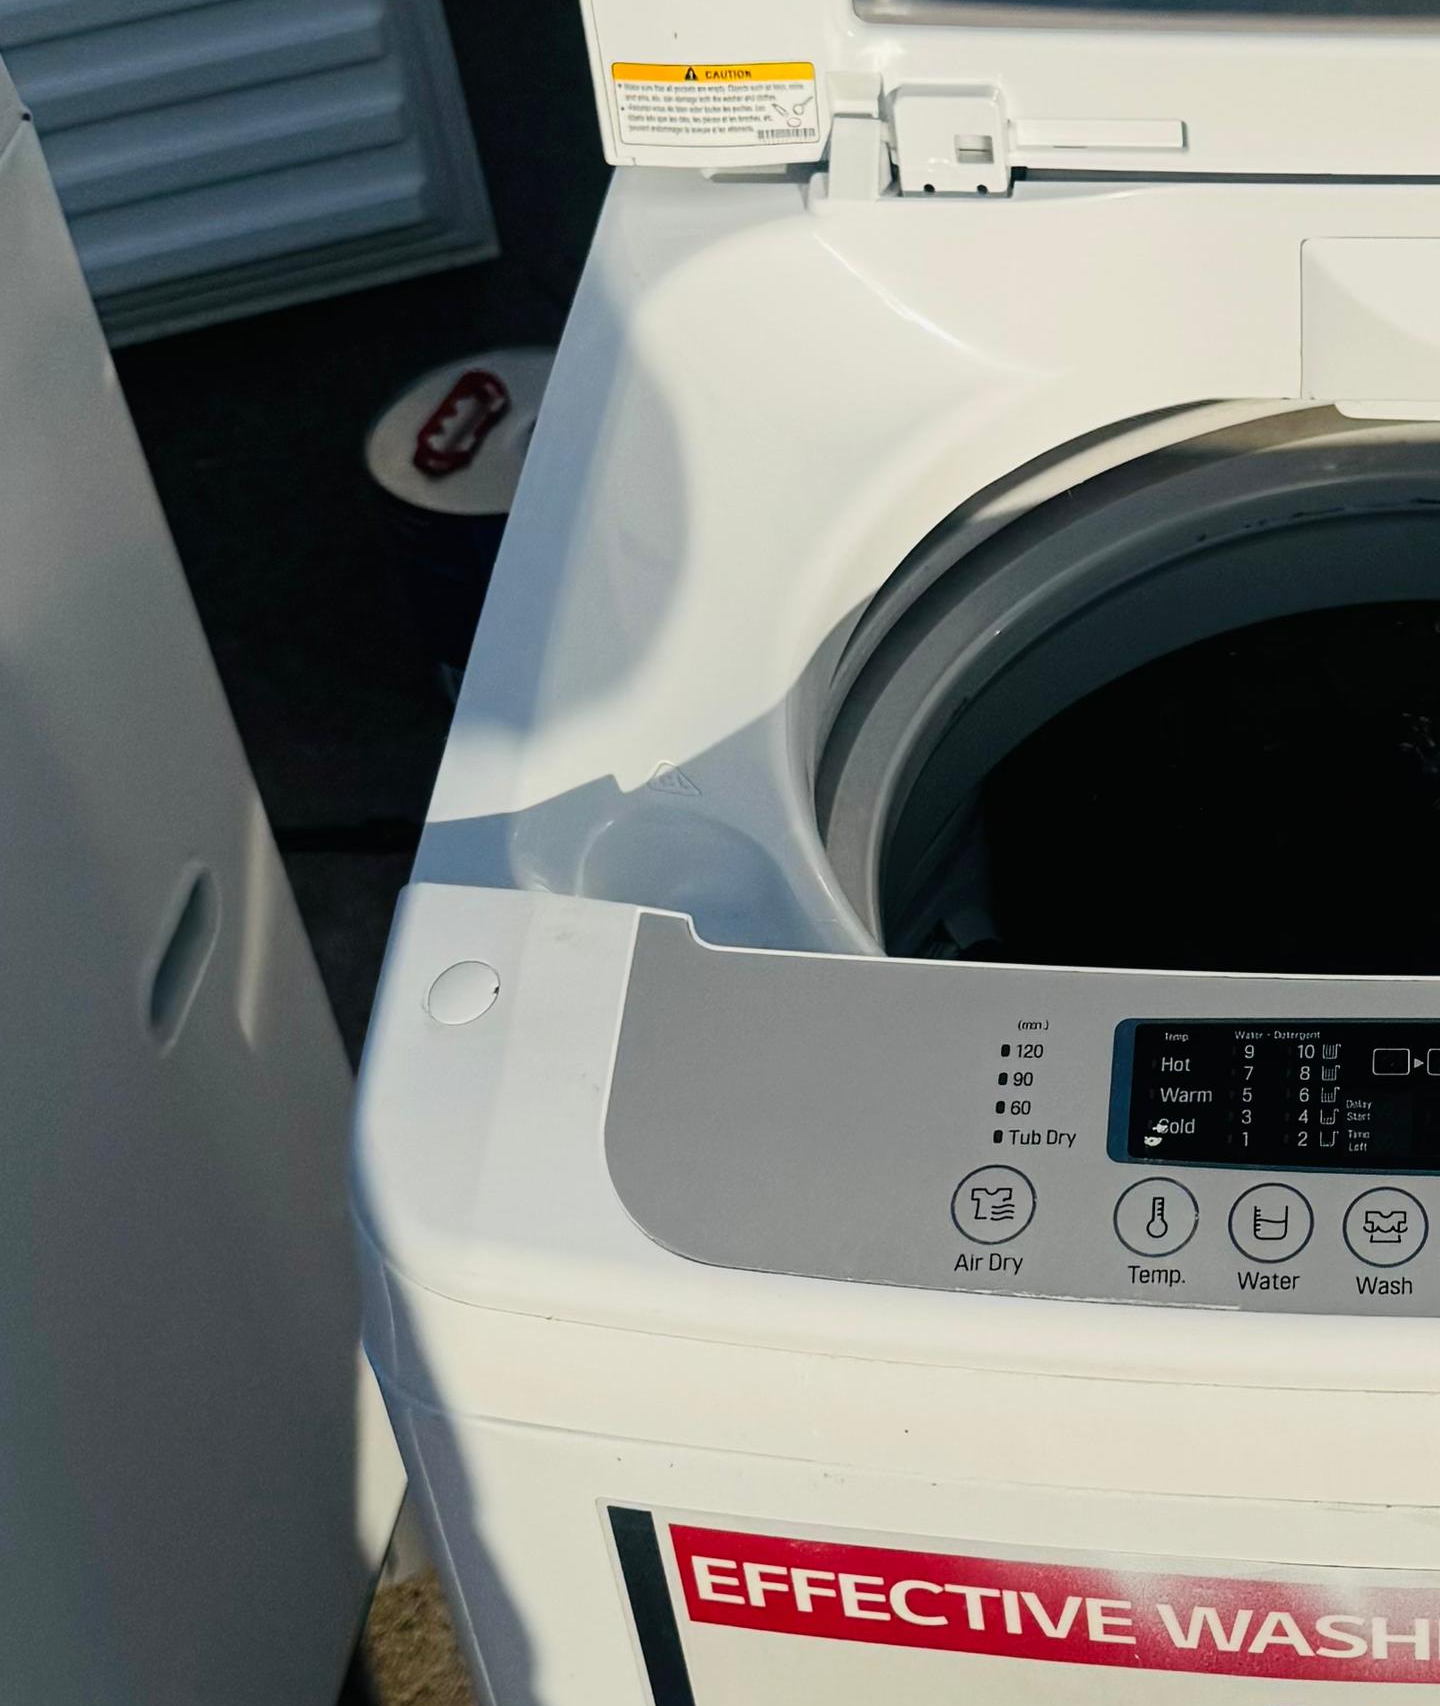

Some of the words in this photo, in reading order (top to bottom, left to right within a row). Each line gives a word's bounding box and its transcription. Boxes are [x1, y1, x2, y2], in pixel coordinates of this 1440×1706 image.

[705, 70, 752, 80] CAUTION
[1234, 1031, 1264, 1040] Water
[1016, 1043, 1043, 1059] 120
[1244, 1045, 1255, 1059] 9
[1297, 1044, 1315, 1059] 10
[1161, 1056, 1191, 1072] Hot
[1012, 1071, 1034, 1087] 90
[1244, 1066, 1254, 1081] 7
[1299, 1066, 1310, 1081] 8
[1160, 1087, 1213, 1103] Warm
[1242, 1087, 1253, 1102] 5
[1299, 1087, 1310, 1102] 6
[1009, 1100, 1031, 1116] 60
[1241, 1109, 1252, 1124] 3
[1297, 1109, 1309, 1124] 4
[1158, 1118, 1196, 1134] Cold
[1008, 1129, 1043, 1146] Tub
[1046, 1129, 1077, 1149] Dry
[1242, 1131, 1249, 1146] 1
[1297, 1131, 1308, 1146] 2
[953, 1253, 984, 1272] Air
[988, 1253, 1024, 1276] Dry
[1127, 1265, 1186, 1286] Temp.
[1237, 1270, 1300, 1291] Water
[1356, 1275, 1413, 1295] Wash
[689, 1553, 1137, 1645] EFFECTIVE
